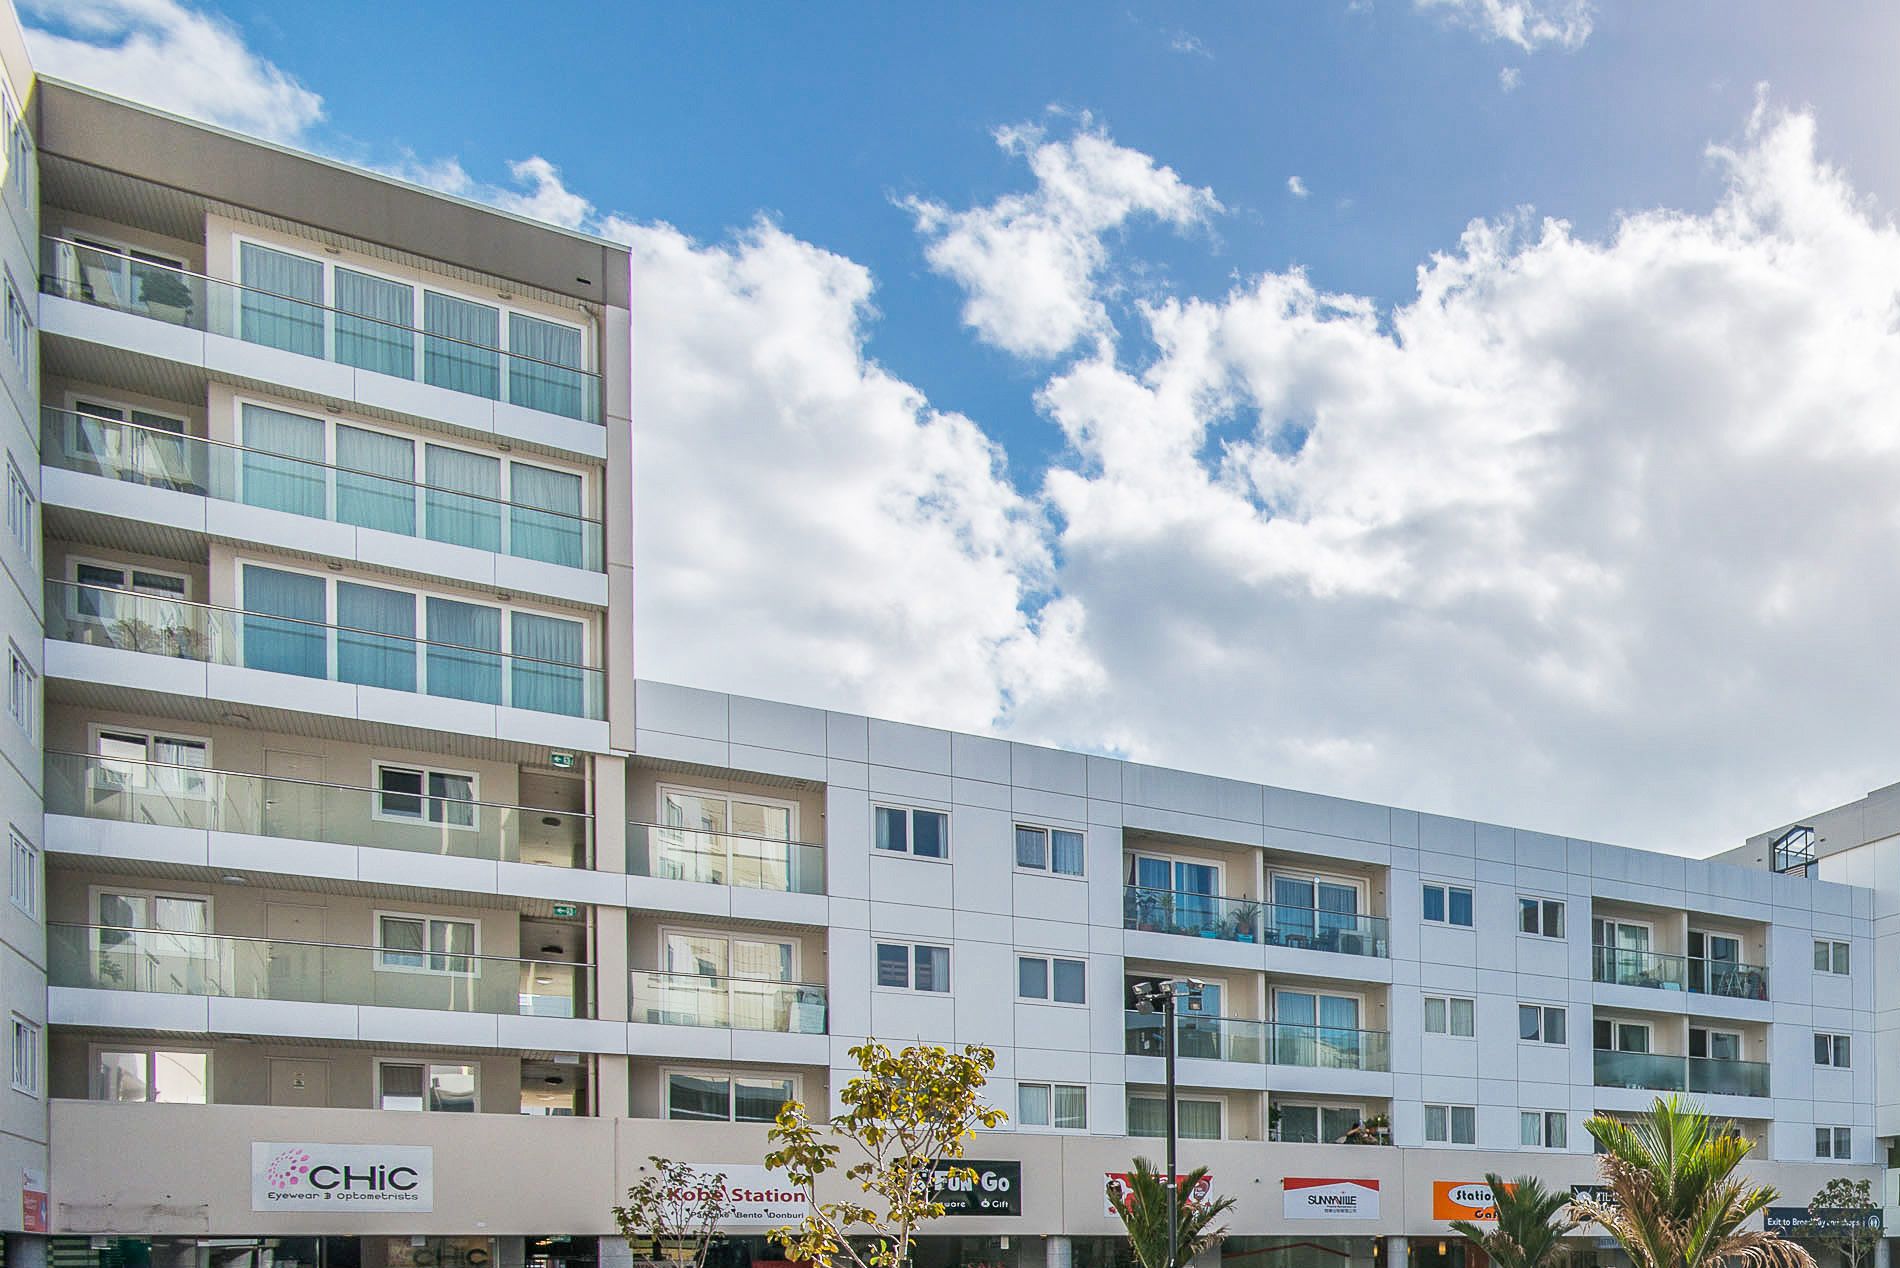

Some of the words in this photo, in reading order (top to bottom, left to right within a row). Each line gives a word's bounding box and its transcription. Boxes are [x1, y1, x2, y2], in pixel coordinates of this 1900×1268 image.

[267, 1192, 320, 1201] Eyewear
[337, 1192, 419, 1202] Optometrists
[667, 1187, 723, 1202] Kobe
[732, 1188, 806, 1202] Station
[992, 1200, 1009, 1208] Gift
[736, 1211, 763, 1219] Bento
[768, 1211, 804, 1219] Donburi
[1767, 1217, 1781, 1226] Exit
[1783, 1217, 1791, 1226] to
